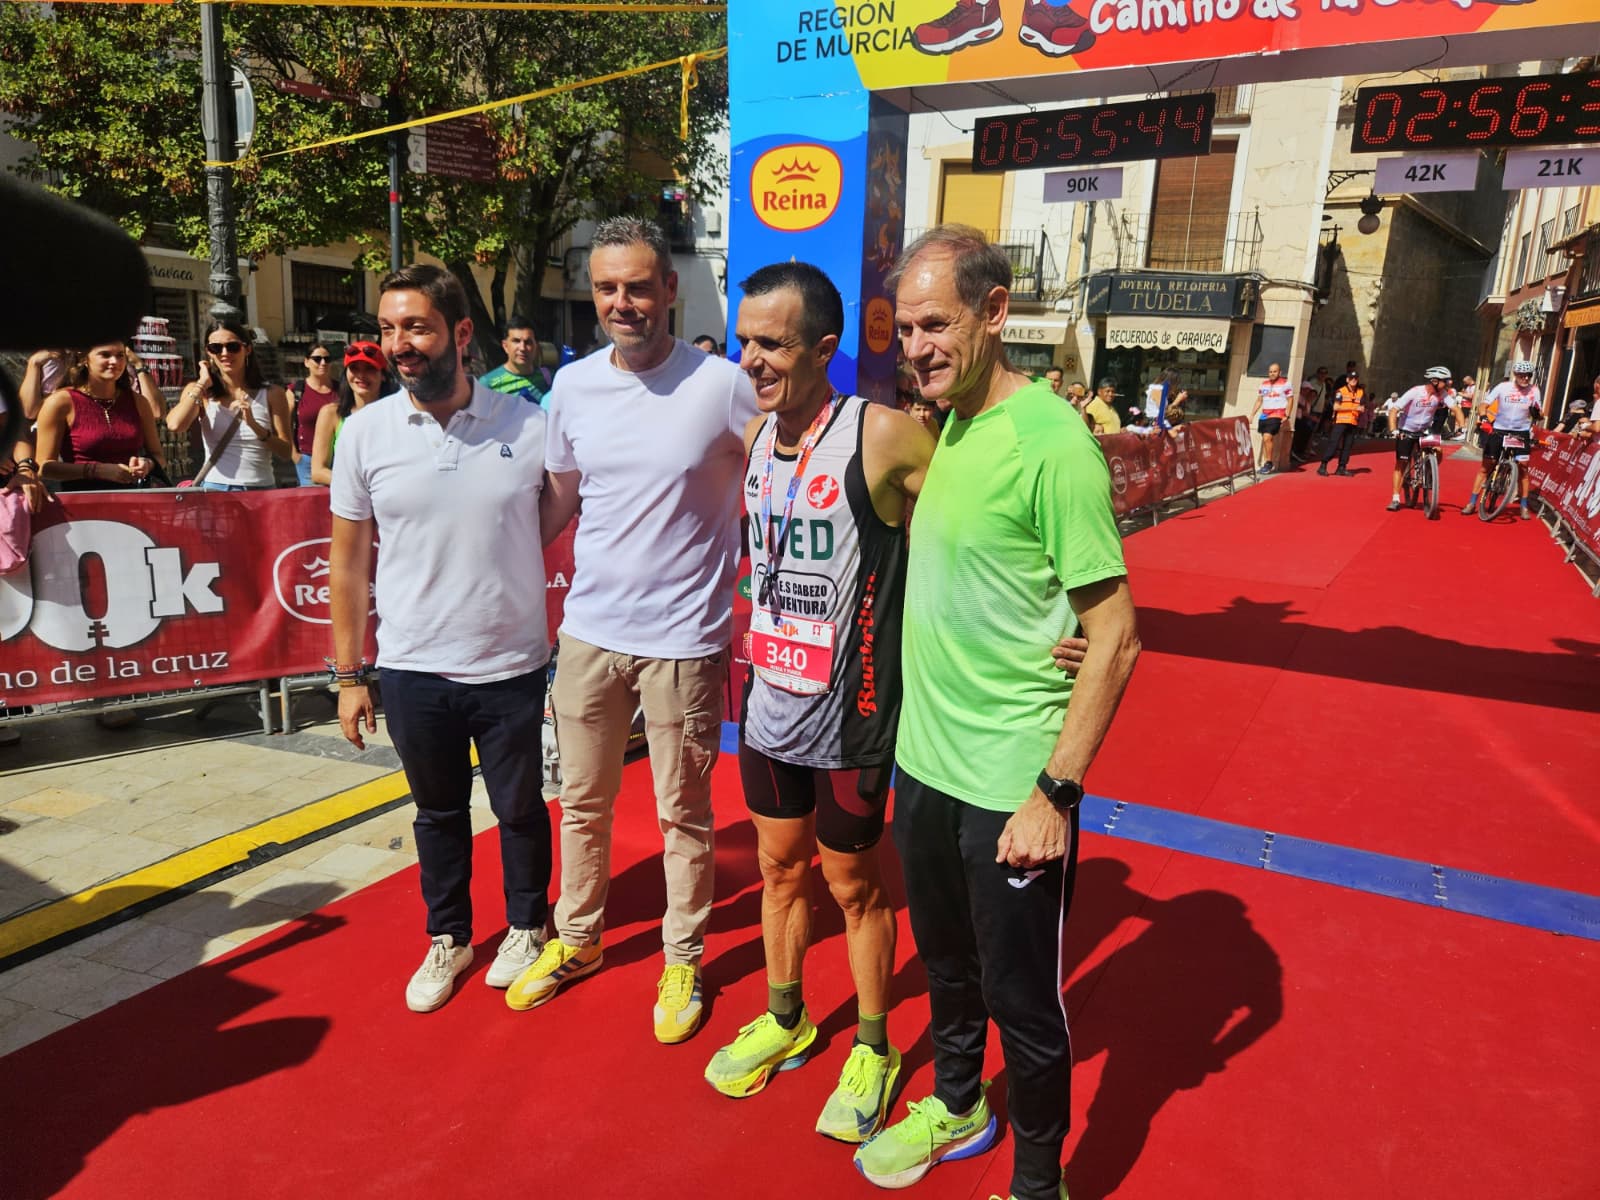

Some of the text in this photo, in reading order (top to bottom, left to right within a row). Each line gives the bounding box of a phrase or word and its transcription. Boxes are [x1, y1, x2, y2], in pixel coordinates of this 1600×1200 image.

[799, 0, 895, 33] REGIÓN
[777, 27, 916, 63] DE MURCIA
[979, 103, 1205, 166] 06:55:44
[1404, 163, 1447, 182] 42K
[1537, 157, 1583, 177] 21K
[1066, 176, 1099, 193] 90K
[763, 188, 827, 211] Reina
[1129, 291, 1213, 312] TUDELA
[1110, 330, 1158, 344] RECUERDOS
[1161, 331, 1171, 344] de
[792, 582, 828, 598] CABEZO
[766, 641, 807, 670] 340
[50, 661, 96, 684] de
[106, 656, 141, 679] la
[152, 651, 229, 674] cruz
